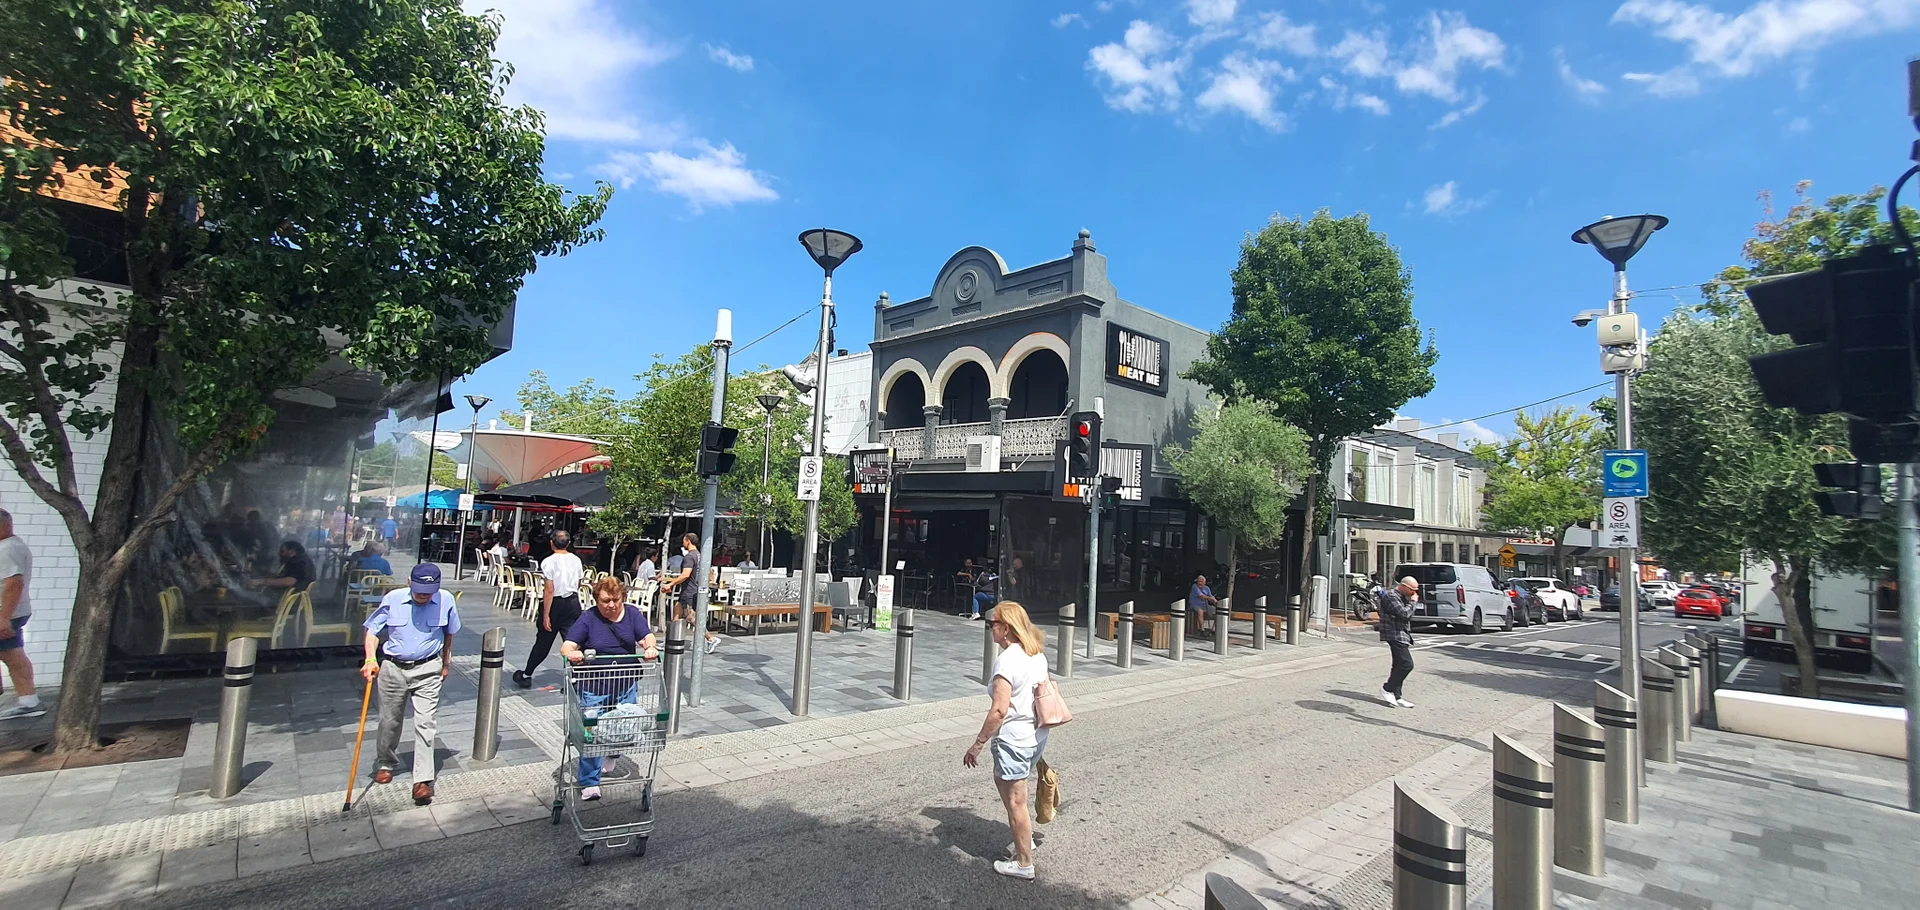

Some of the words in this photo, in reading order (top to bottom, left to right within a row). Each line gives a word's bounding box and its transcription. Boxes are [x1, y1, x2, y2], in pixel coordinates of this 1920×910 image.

[1118, 364, 1145, 382] MEAT
[1146, 372, 1160, 386] ME
[854, 483, 876, 493] MEAT
